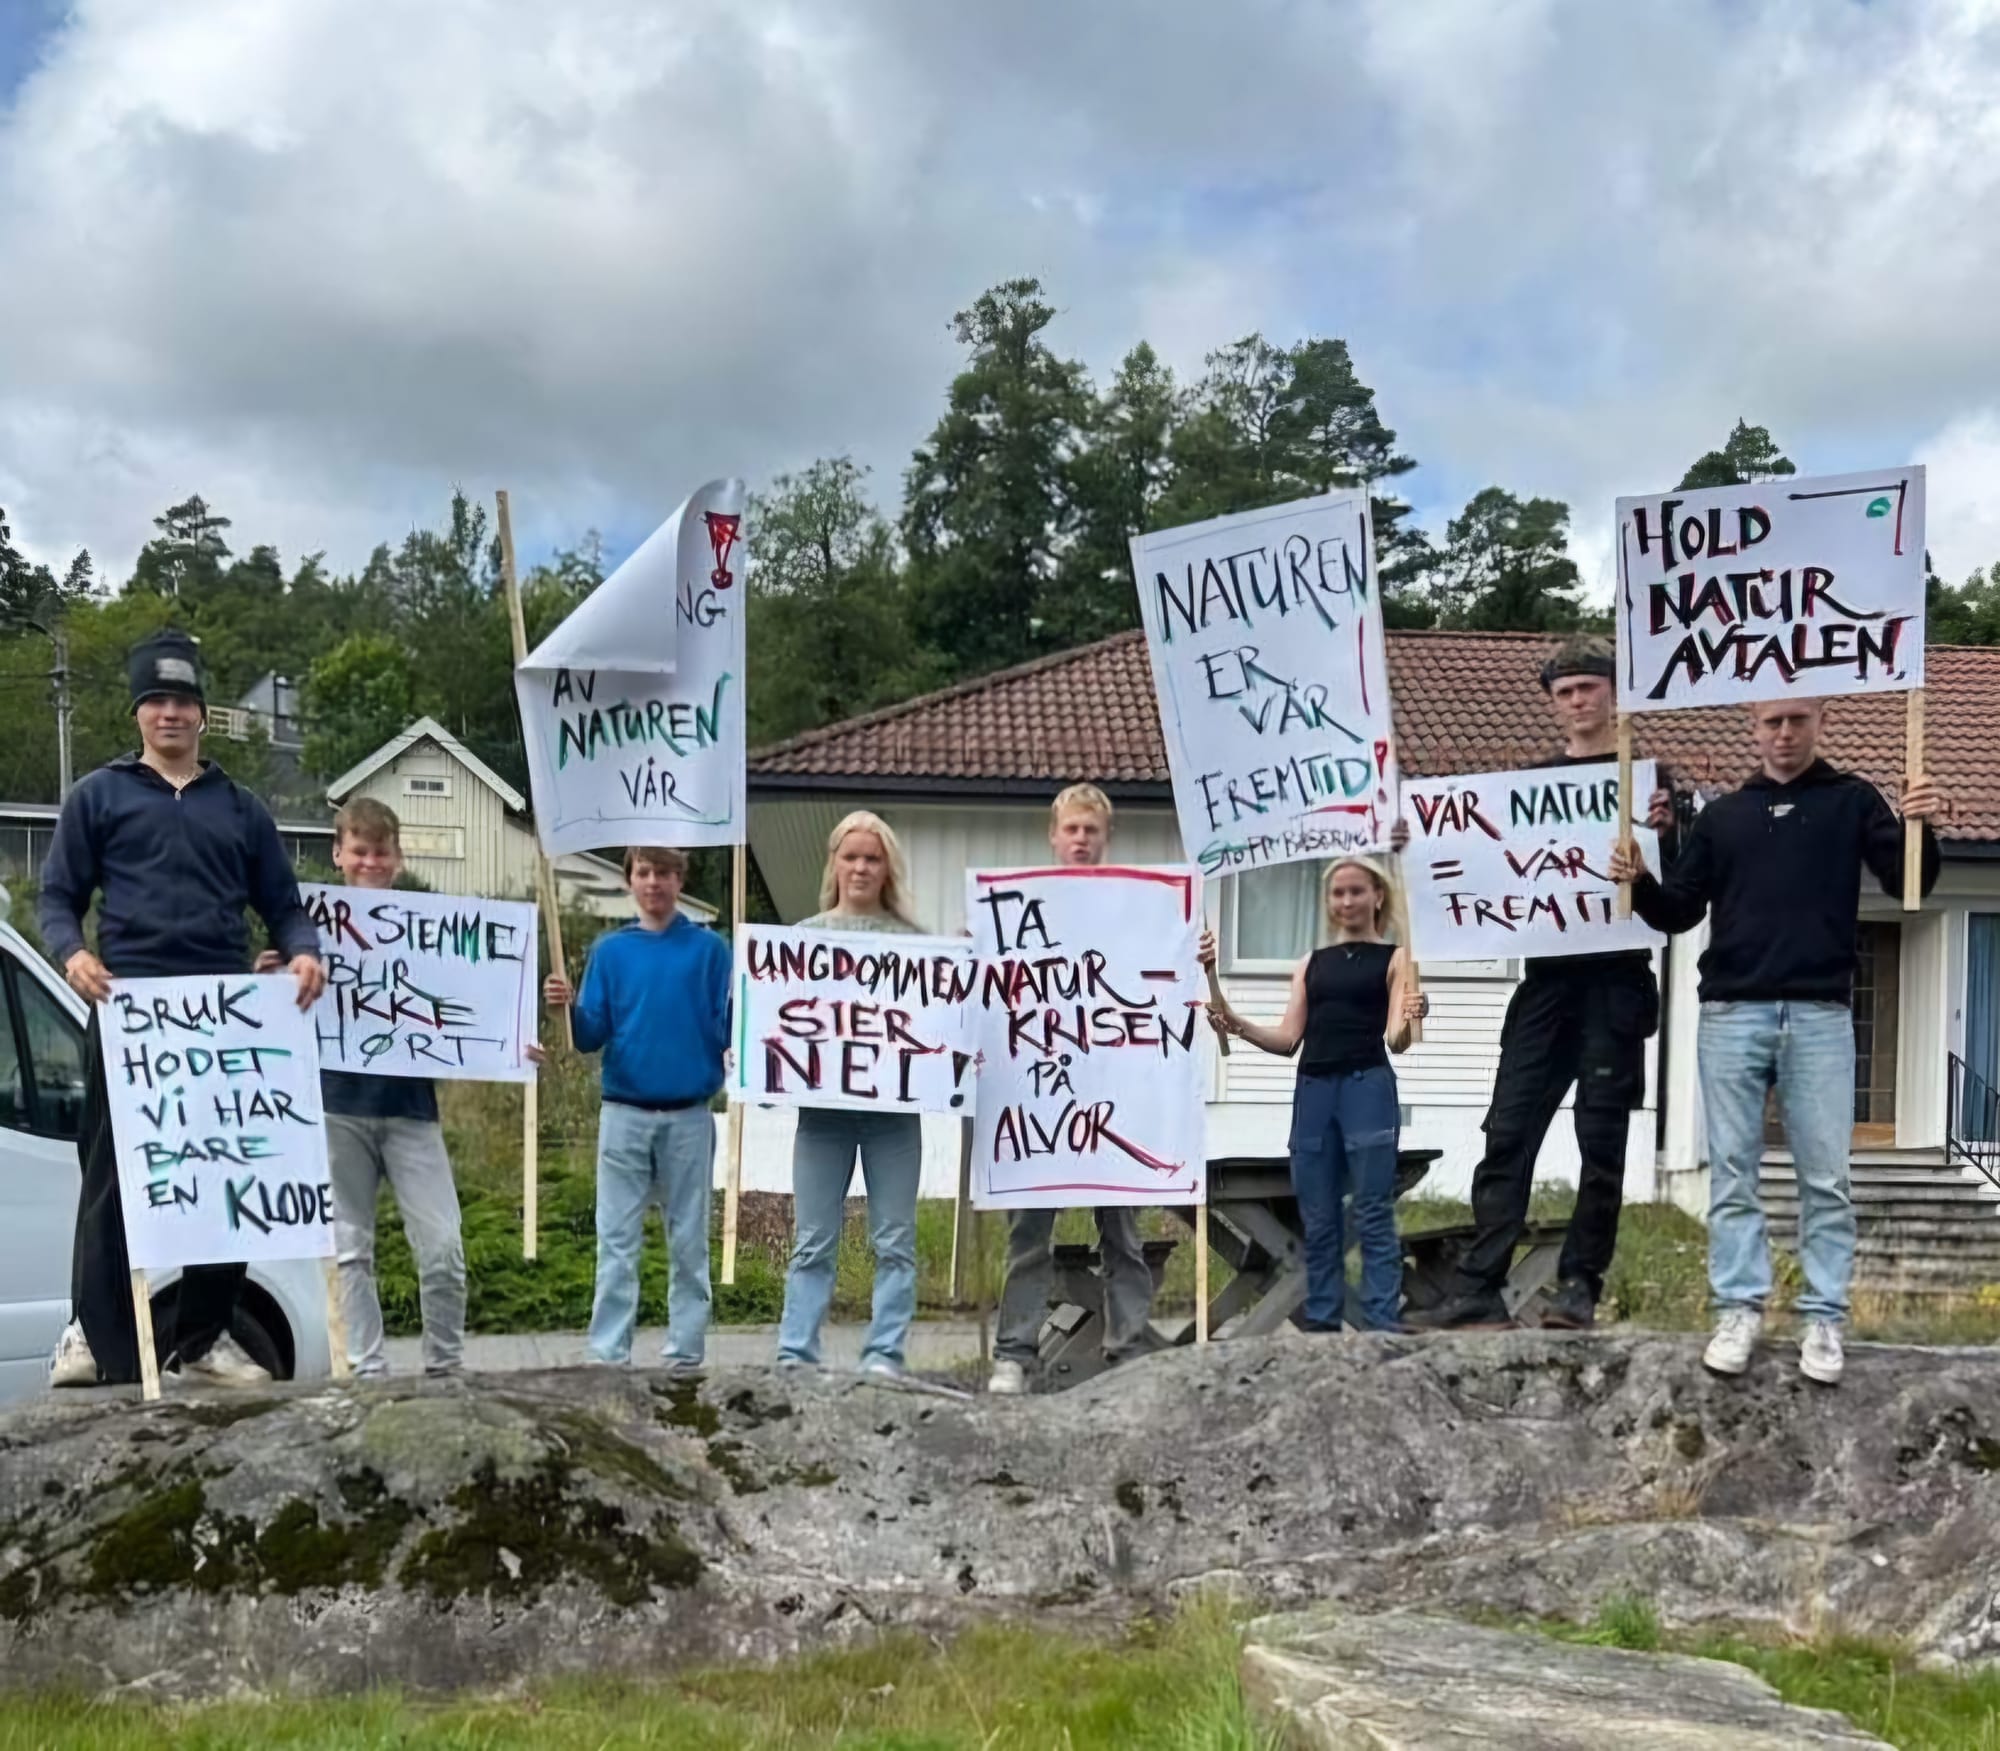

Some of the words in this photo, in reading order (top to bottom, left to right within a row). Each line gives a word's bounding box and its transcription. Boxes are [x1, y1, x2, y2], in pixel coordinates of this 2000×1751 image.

[1633, 500, 1771, 573] HOLD
[1154, 522, 1369, 645] NATUREN
[1648, 566, 1888, 636] NATUR
[553, 668, 596, 708] AV
[1194, 645, 1298, 700] ER
[558, 671, 734, 771] NATUREN
[620, 756, 703, 817] VÅR
[1411, 785, 1503, 841] VÅR
[1510, 779, 1620, 828] NATUR
[1503, 838, 1619, 884] VÅR
[368, 904, 525, 965] STEMME
[976, 887, 1062, 955] TA
[1440, 890, 1612, 932] FREMTI
[324, 953, 438, 1002] BLIR
[747, 938, 979, 1008] UNGDOMMEN
[114, 980, 263, 1037] BRUK
[333, 984, 479, 1030] IKKE
[778, 996, 948, 1053] SIER
[1006, 1003, 1196, 1060] KRISEN
[122, 1043, 292, 1088] HODET
[315, 1018, 507, 1067] HØRT
[1027, 1054, 1075, 1098] PÅ
[214, 1088, 319, 1128] HAR
[134, 1136, 285, 1174] BARE
[993, 1099, 1186, 1178] ALVOR
[144, 1172, 199, 1214] EN
[225, 1174, 334, 1235] KLODE
